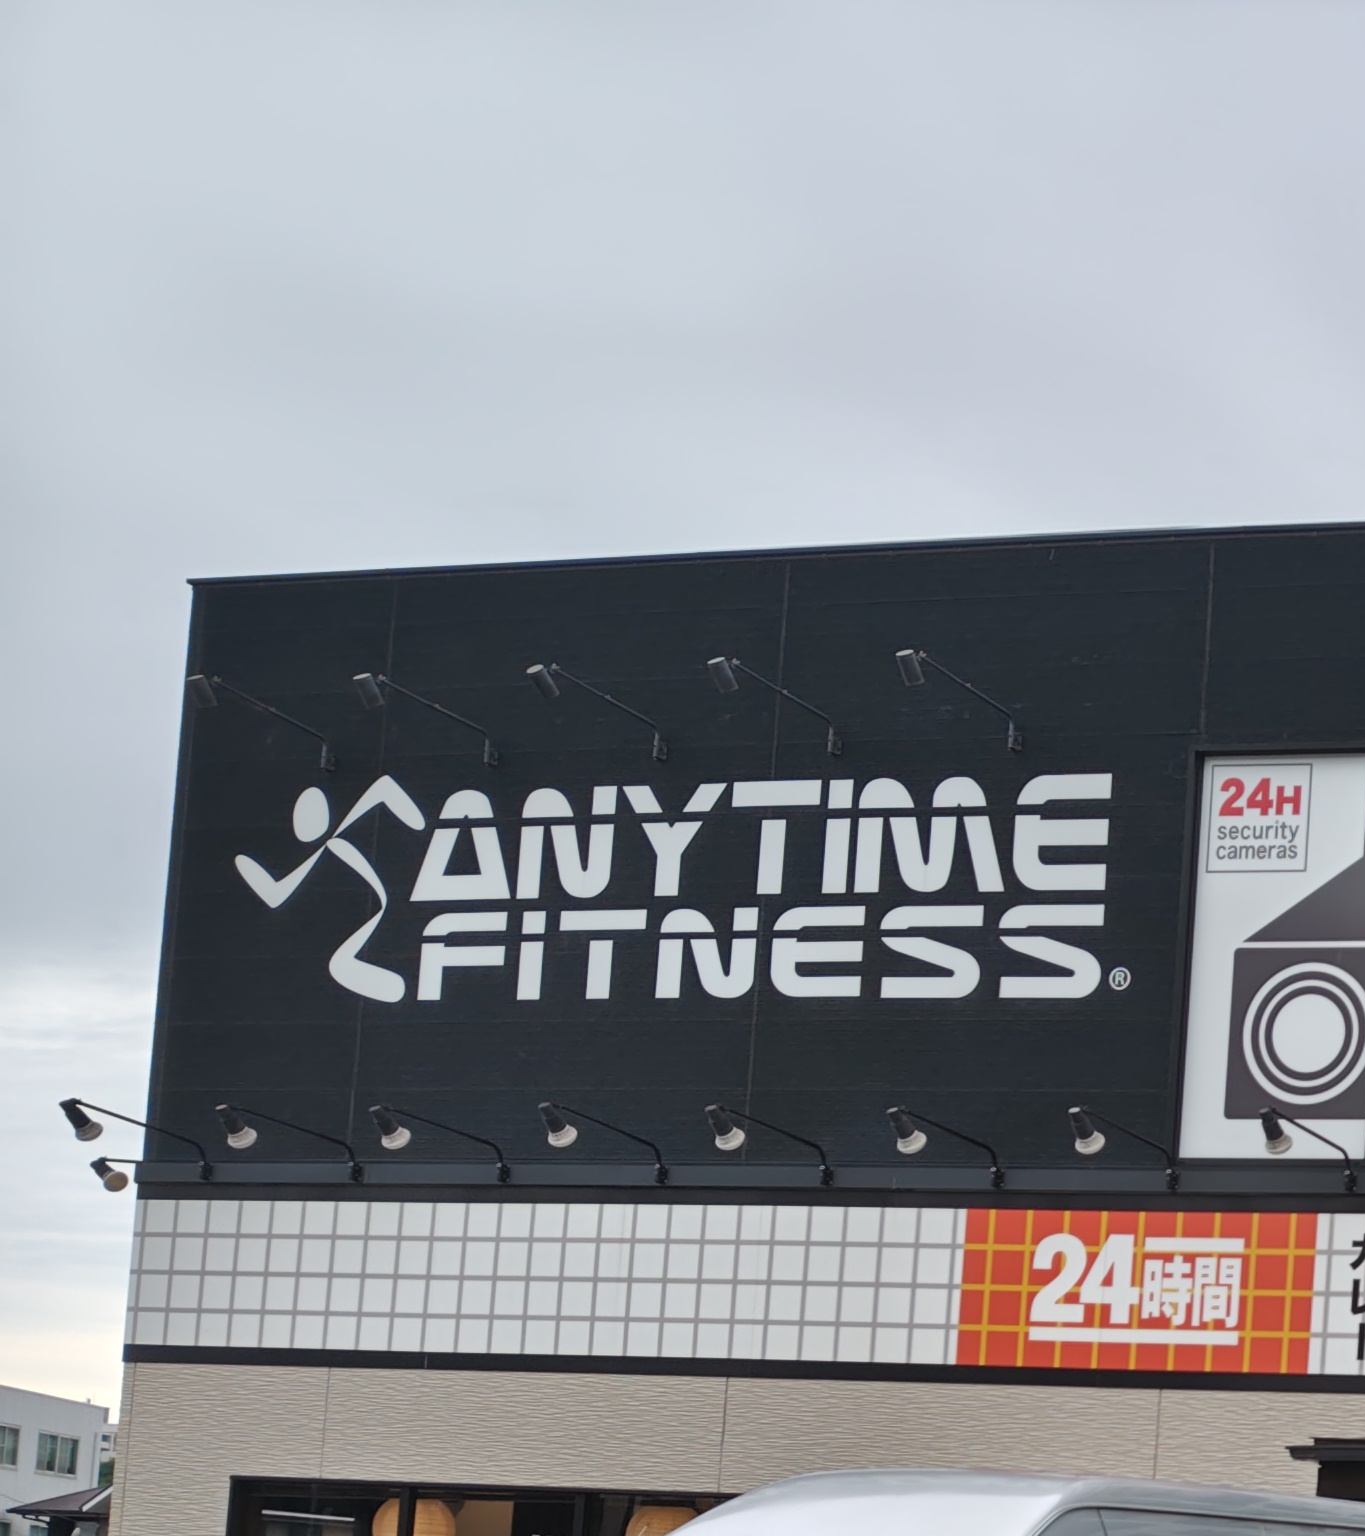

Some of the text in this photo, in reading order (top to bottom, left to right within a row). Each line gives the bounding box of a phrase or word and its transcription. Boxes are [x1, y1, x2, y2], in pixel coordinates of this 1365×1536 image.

[1218, 777, 1302, 817] 24H
[409, 773, 1113, 902] ANYTIME
[1215, 843, 1298, 860] cameras
[1216, 820, 1300, 844] security
[1029, 1233, 1242, 1329] 24時間
